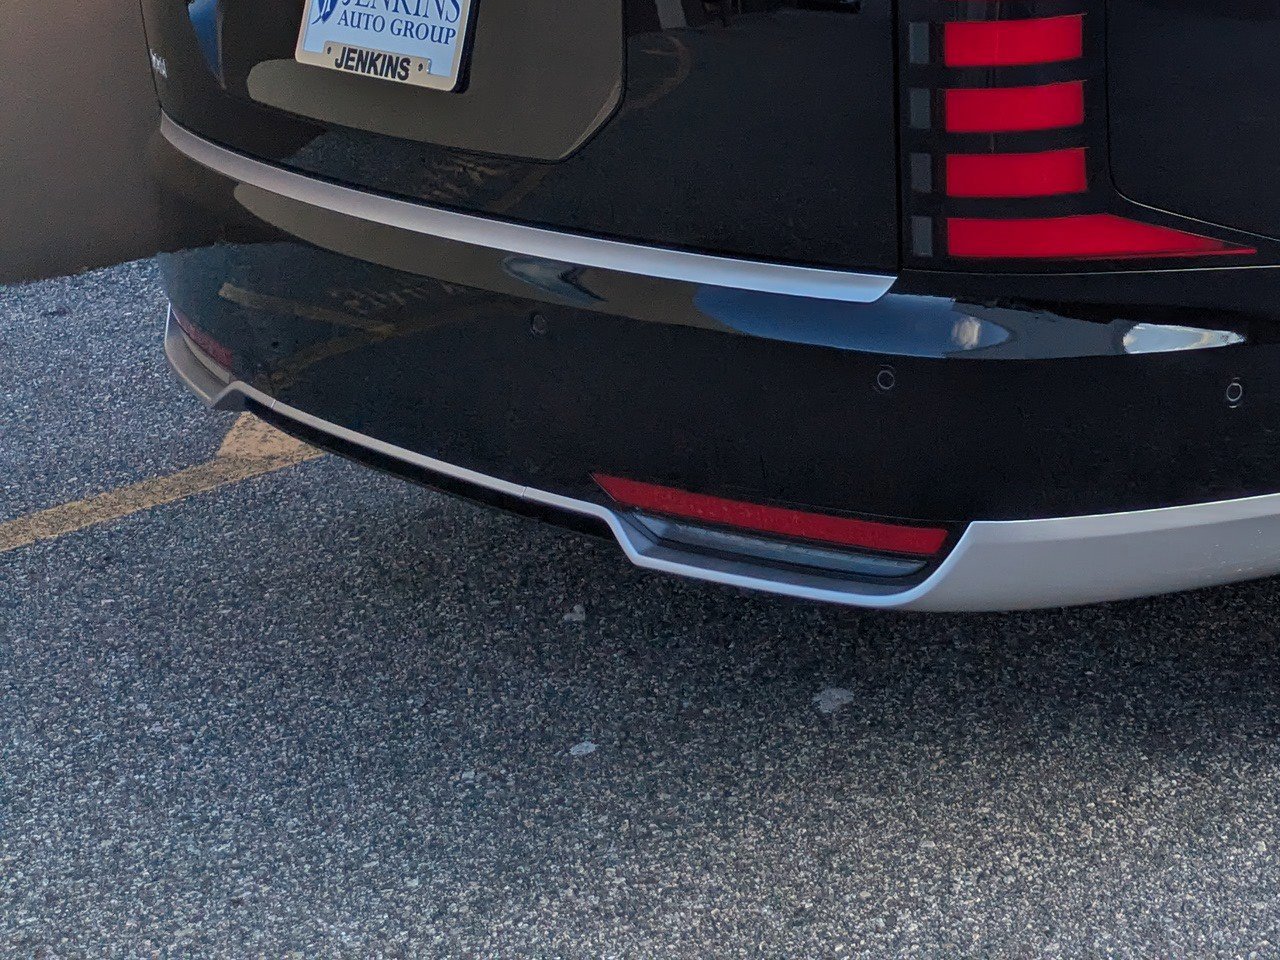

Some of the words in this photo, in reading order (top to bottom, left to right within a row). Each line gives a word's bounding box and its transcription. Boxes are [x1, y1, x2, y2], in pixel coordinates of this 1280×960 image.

[336, 8, 386, 33] AUTO
[389, 17, 457, 46] GROUP
[334, 46, 412, 81] JENKINS
